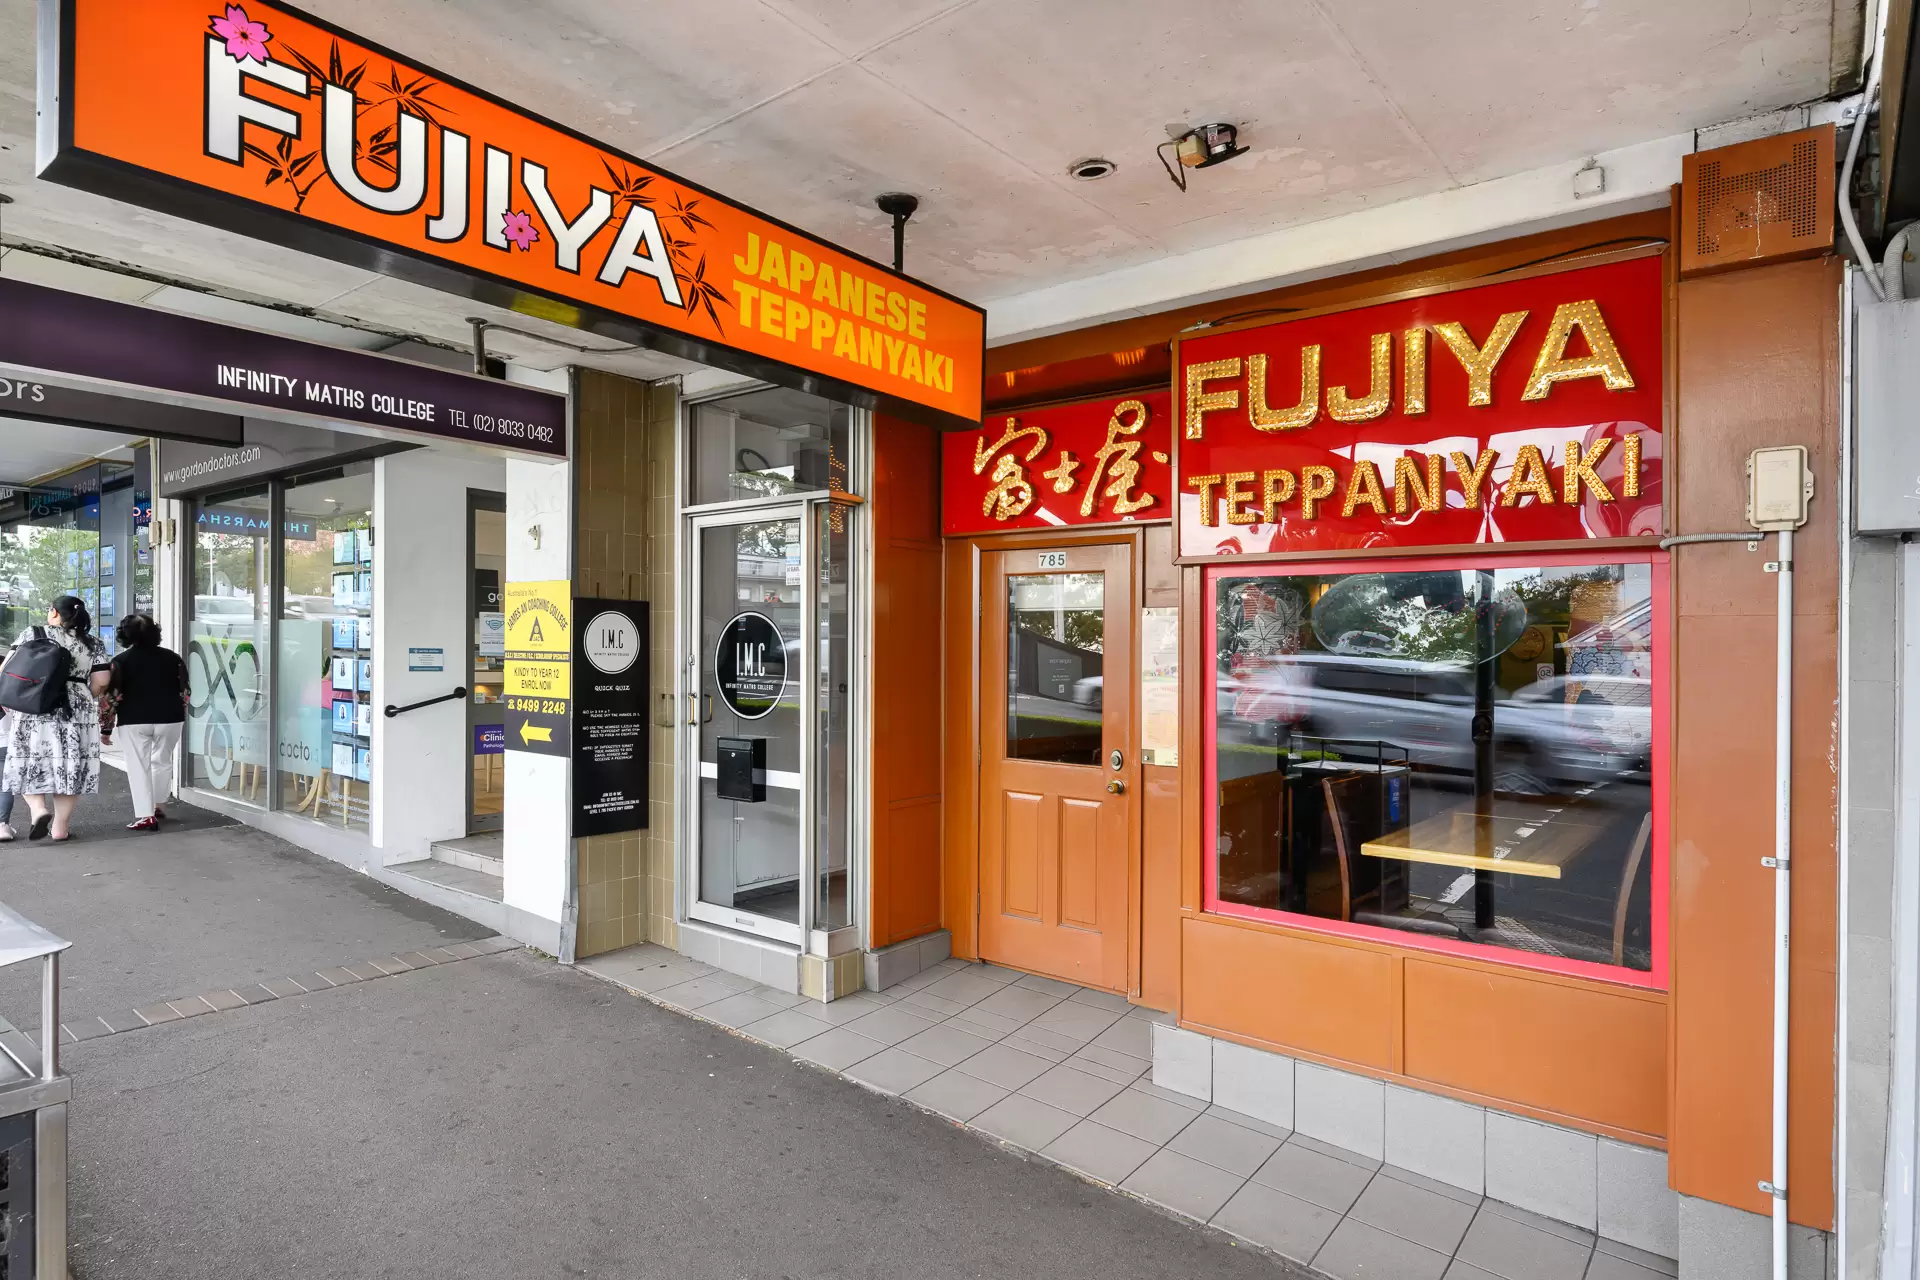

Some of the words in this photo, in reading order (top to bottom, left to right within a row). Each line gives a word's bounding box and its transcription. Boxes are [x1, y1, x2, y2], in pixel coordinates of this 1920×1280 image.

[203, 32, 687, 309] FUJIYA
[733, 232, 927, 340] JAPANESE
[733, 279, 954, 394] TEPPANYAKI
[1185, 299, 1635, 441] FUJIYA
[217, 364, 298, 397] INFINITY
[305, 380, 365, 410] MATHS
[371, 394, 435, 422] COLLEGE
[448, 408, 470, 429] TEL
[473, 413, 495, 432] (02)
[498, 418, 525, 437] 8033
[527, 423, 554, 443] 0482
[163, 446, 261, 483] www.gordondoctors.com
[1188, 434, 1643, 527] TEPPANYAKI
[1039, 554, 1065, 567] 785
[507, 607, 522, 631] JAMES
[527, 598, 550, 613] COACHING
[549, 603, 569, 632] COLLEGE
[602, 629, 624, 649] I.M.C
[514, 668, 529, 676] KINDY
[531, 668, 538, 678] TO
[539, 668, 552, 678] YEAR
[554, 669, 560, 678] 12
[736, 642, 765, 676] I.M.C
[521, 680, 538, 690] ENROL
[539, 680, 552, 690] NOW
[516, 698, 540, 712] 9499
[542, 700, 566, 715] 2248
